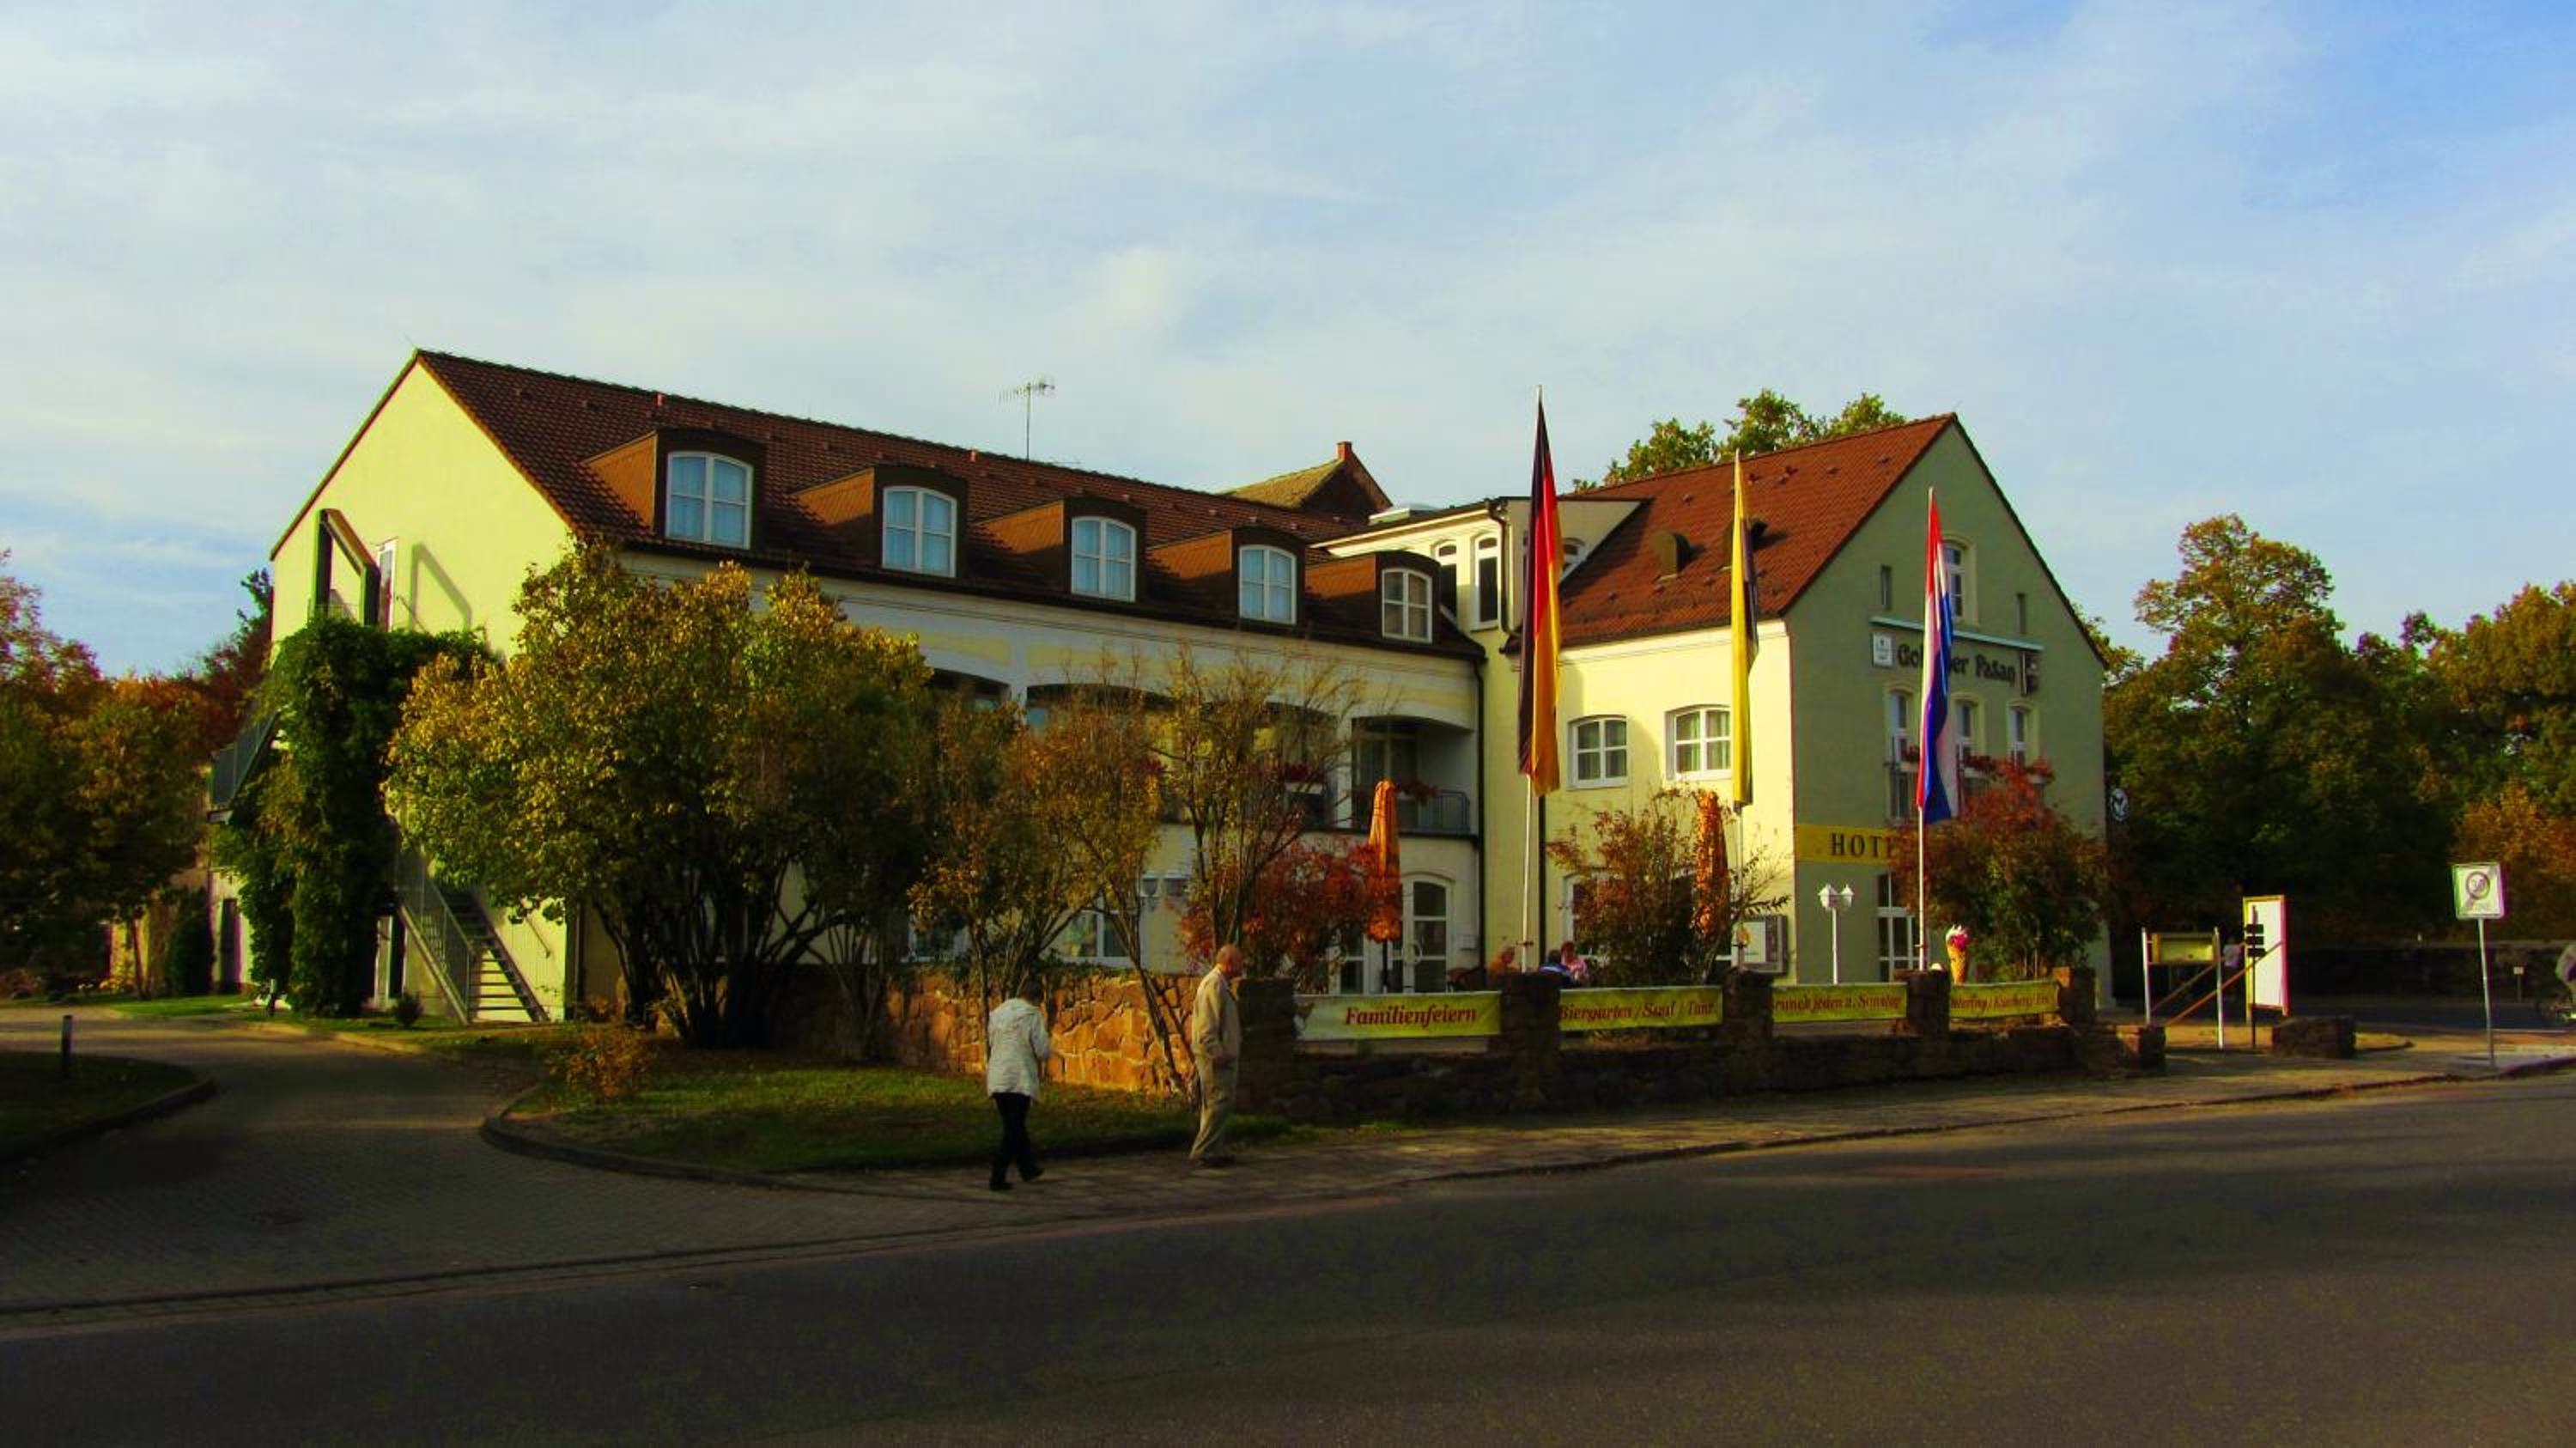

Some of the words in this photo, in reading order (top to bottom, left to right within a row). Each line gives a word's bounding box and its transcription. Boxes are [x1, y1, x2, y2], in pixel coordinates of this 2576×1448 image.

[1898, 643, 1969, 675] Goler
[1831, 832, 1897, 858] HOTE
[1346, 1004, 1477, 1027] Familienfeiern
[1774, 995, 1810, 1012] runch
